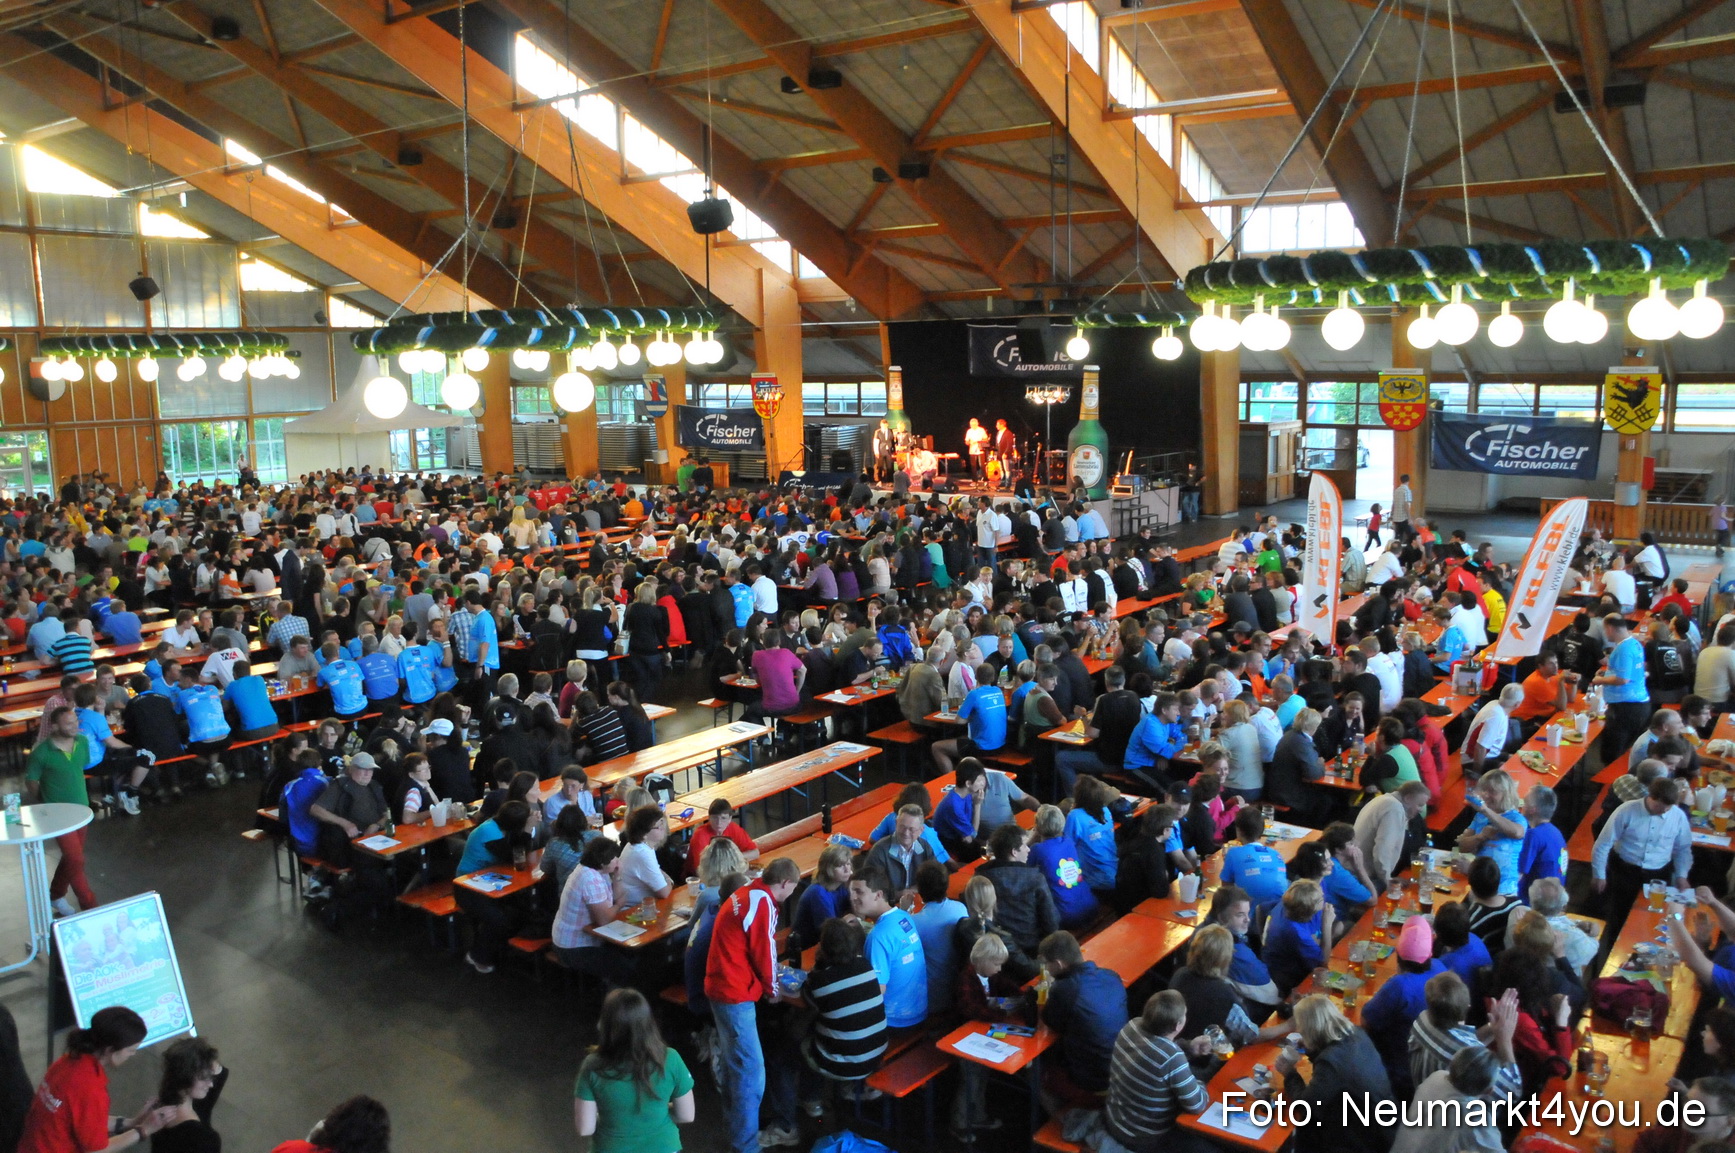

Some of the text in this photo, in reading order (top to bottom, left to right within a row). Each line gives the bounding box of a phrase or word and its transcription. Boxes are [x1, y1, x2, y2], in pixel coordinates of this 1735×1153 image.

[1014, 363, 1074, 371] AUTOMOBILE
[706, 424, 757, 438] Fischer
[1486, 438, 1589, 460] Fischer
[1494, 459, 1579, 470] AUTOMOBILE
[1522, 515, 1571, 608] KLEBL
[1550, 526, 1580, 591] www.klebl.de
[74, 973, 93, 986] Die
